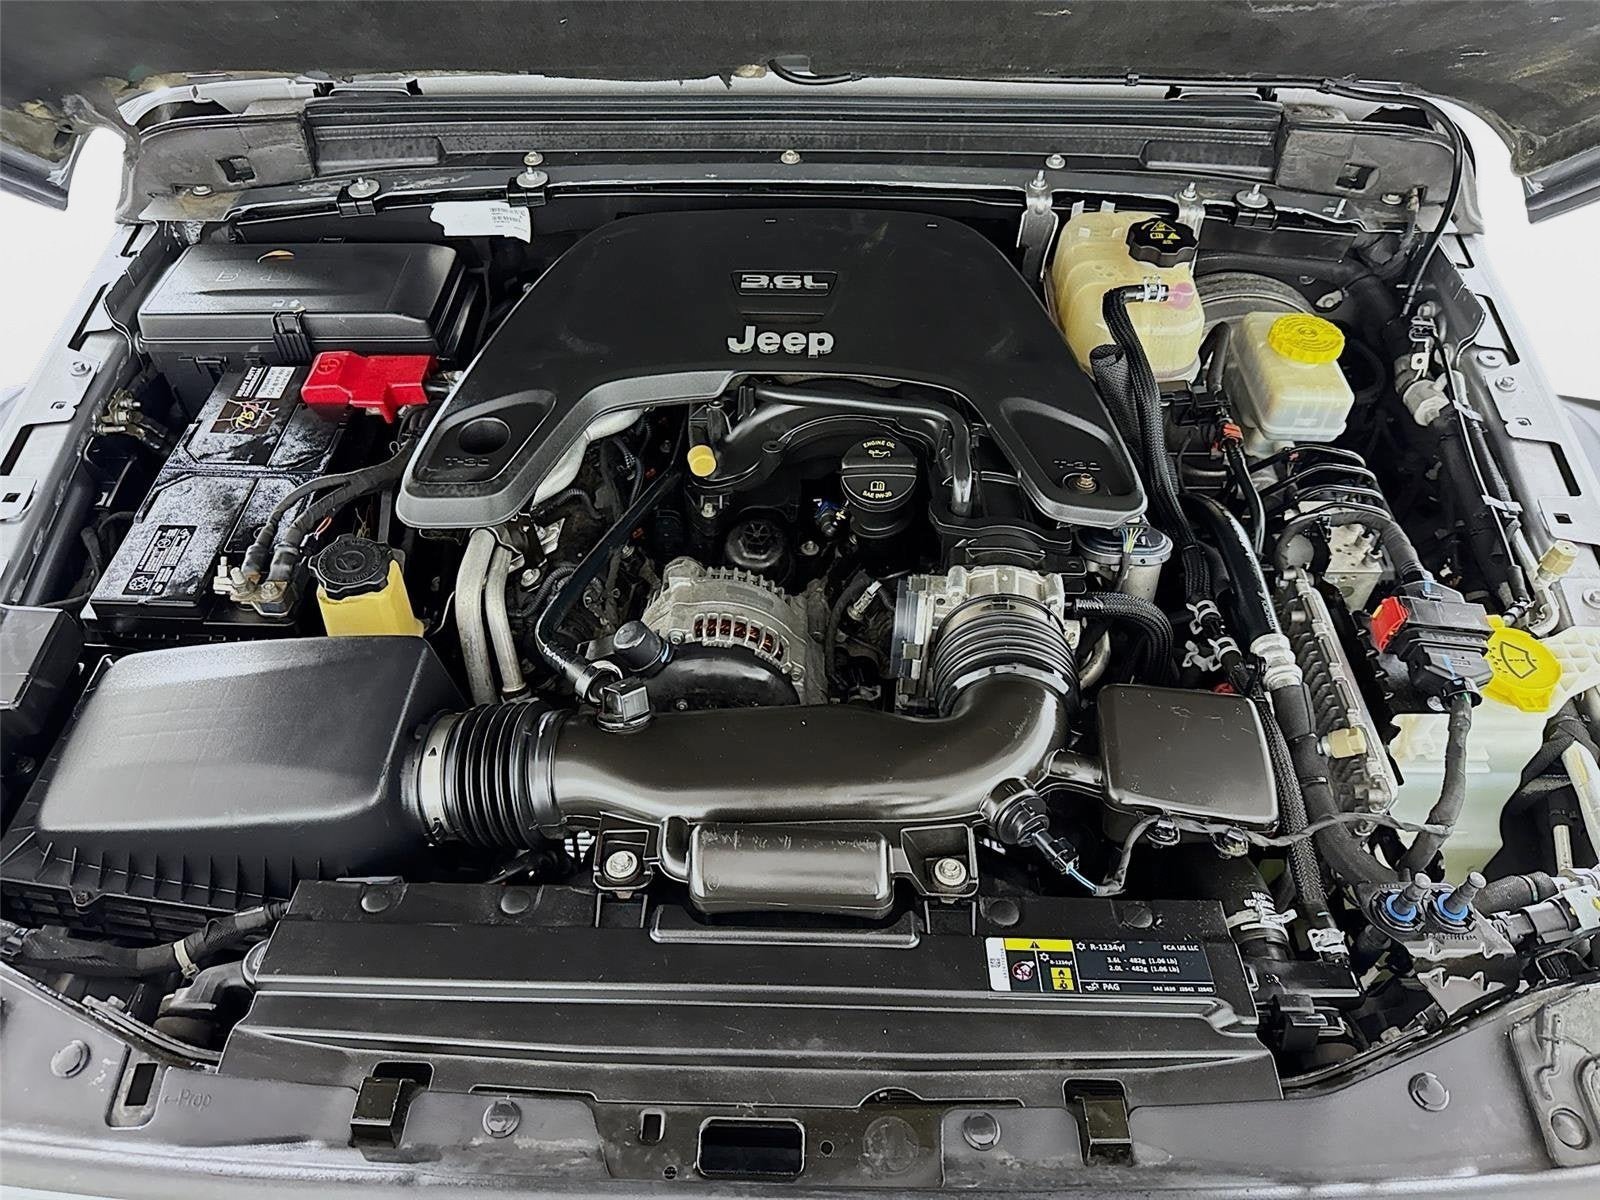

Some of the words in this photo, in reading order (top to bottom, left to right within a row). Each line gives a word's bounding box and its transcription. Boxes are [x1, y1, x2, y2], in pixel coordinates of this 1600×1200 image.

[741, 275, 828, 289] 3.6L
[727, 325, 834, 359] Jeep
[863, 440, 885, 448] ENGINE
[862, 490, 875, 499] SAE
[875, 491, 893, 499] 0W-20
[1089, 944, 1126, 952] R-1234yf
[1102, 983, 1120, 991] PAG
[177, 1088, 213, 1111] Prop
